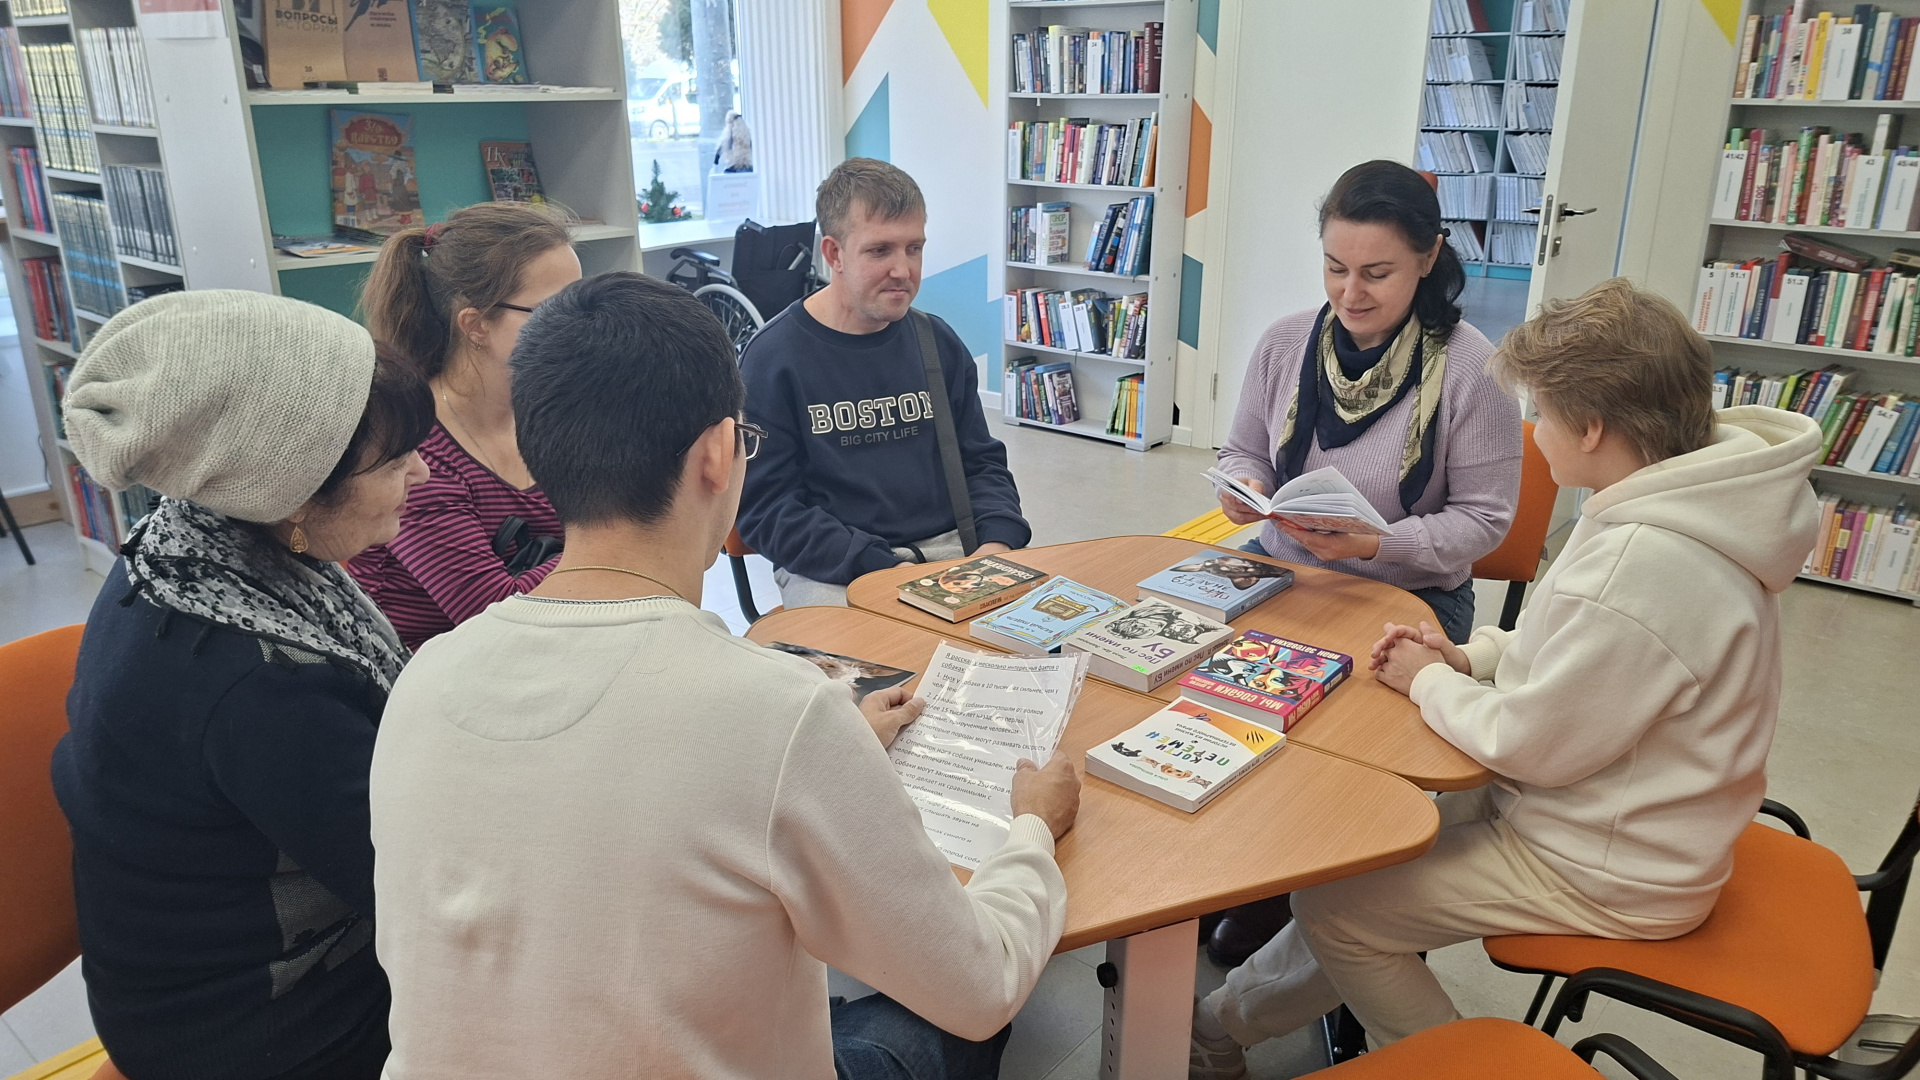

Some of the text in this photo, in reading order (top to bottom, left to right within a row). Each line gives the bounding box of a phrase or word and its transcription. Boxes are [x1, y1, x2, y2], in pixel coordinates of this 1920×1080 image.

[275, 9, 338, 25] ВОПРОСЫ
[276, 20, 338, 33] ИСТОРИИ
[1725, 152, 1745, 160] 41/42
[1730, 271, 1746, 279] 51.1
[840, 426, 919, 446] BIG CITY LIFE
[1006, 616, 1054, 634] БЕЛЫЙ ПУДЕЛЬ
[1085, 631, 1162, 665] Пес по имени
[950, 654, 978, 667] расскау
[962, 680, 981, 688] обаки
[919, 722, 950, 734] Некоторые
[951, 731, 974, 741] породы
[975, 737, 992, 746] могут
[992, 740, 1021, 750] развивать
[905, 738, 936, 752] Отпечаток
[951, 751, 974, 761] собаки
[1145, 731, 1230, 766] ПЕРЕМЕН
[1155, 744, 1201, 764] КОГТИ
[921, 755, 952, 766] отпечаток
[894, 758, 917, 769] Собаки
[917, 764, 935, 774] могут
[934, 769, 967, 783] запомнить
[916, 776, 938, 785] делает
[946, 784, 989, 799] сравнимыми
[964, 855, 980, 863] соба
